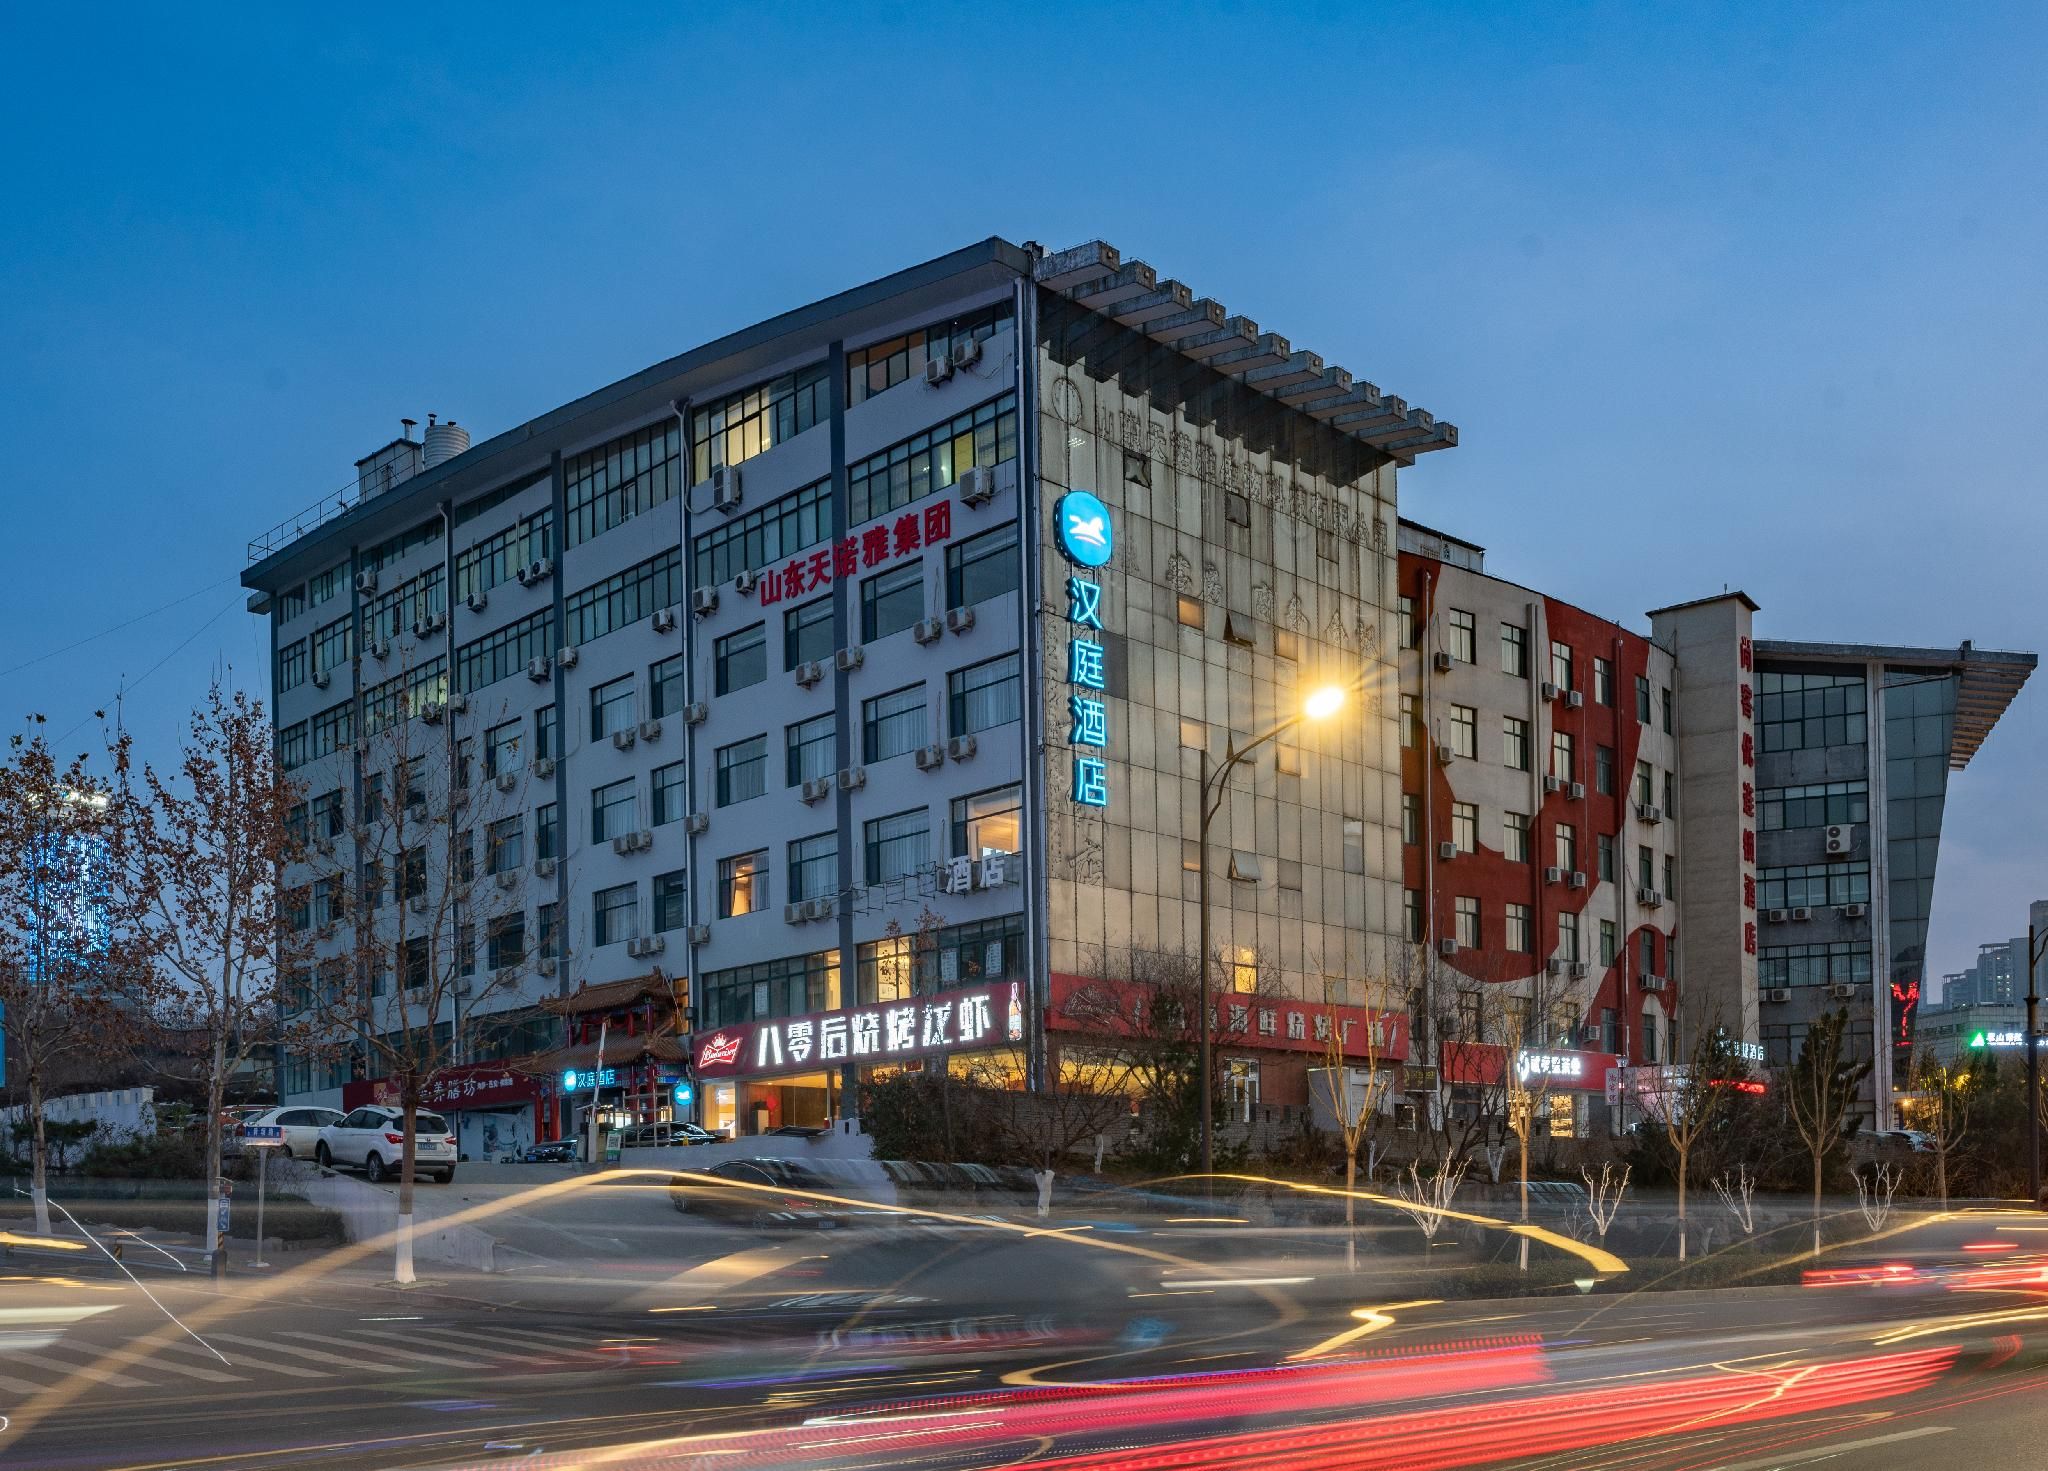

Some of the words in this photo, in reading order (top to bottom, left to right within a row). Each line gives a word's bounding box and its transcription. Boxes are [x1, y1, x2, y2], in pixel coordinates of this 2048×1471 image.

[760, 499, 952, 607] 山东天诺雅集团
[1068, 576, 1108, 807] 汉庭酒店
[945, 855, 1005, 894] 酒店
[757, 994, 992, 1067] 八零后烧烤龙虾
[577, 1068, 616, 1088] 汉庭酒店
